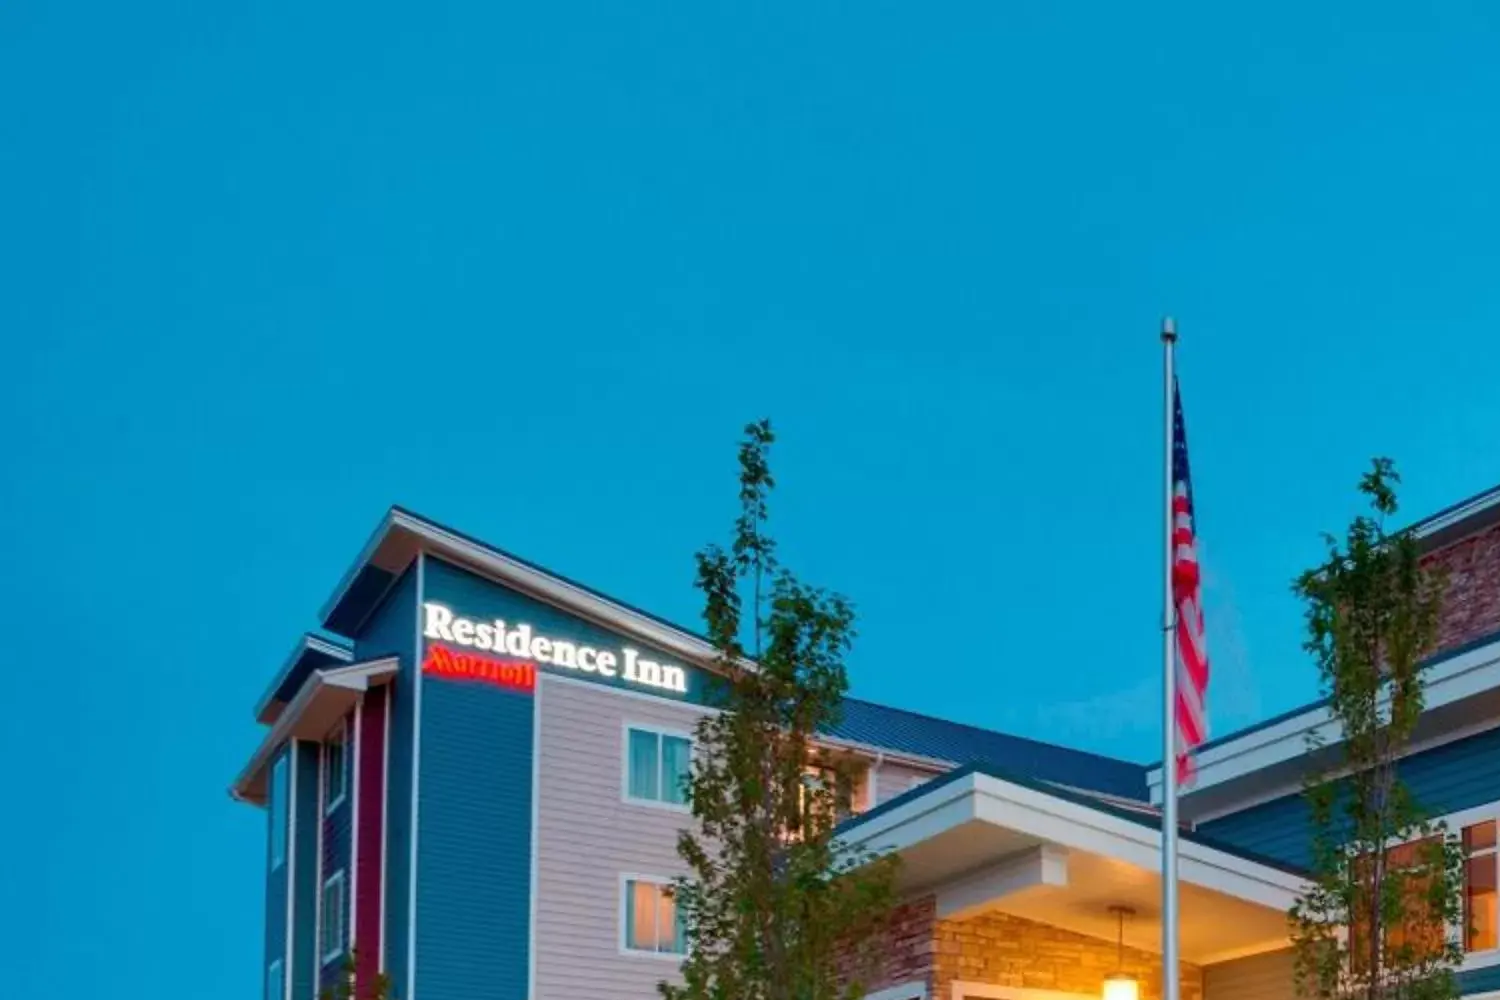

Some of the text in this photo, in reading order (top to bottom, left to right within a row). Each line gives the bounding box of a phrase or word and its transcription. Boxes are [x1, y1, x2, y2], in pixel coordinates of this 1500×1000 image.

[423, 603, 687, 693] Residence Inn
[423, 643, 536, 688] Marriott
